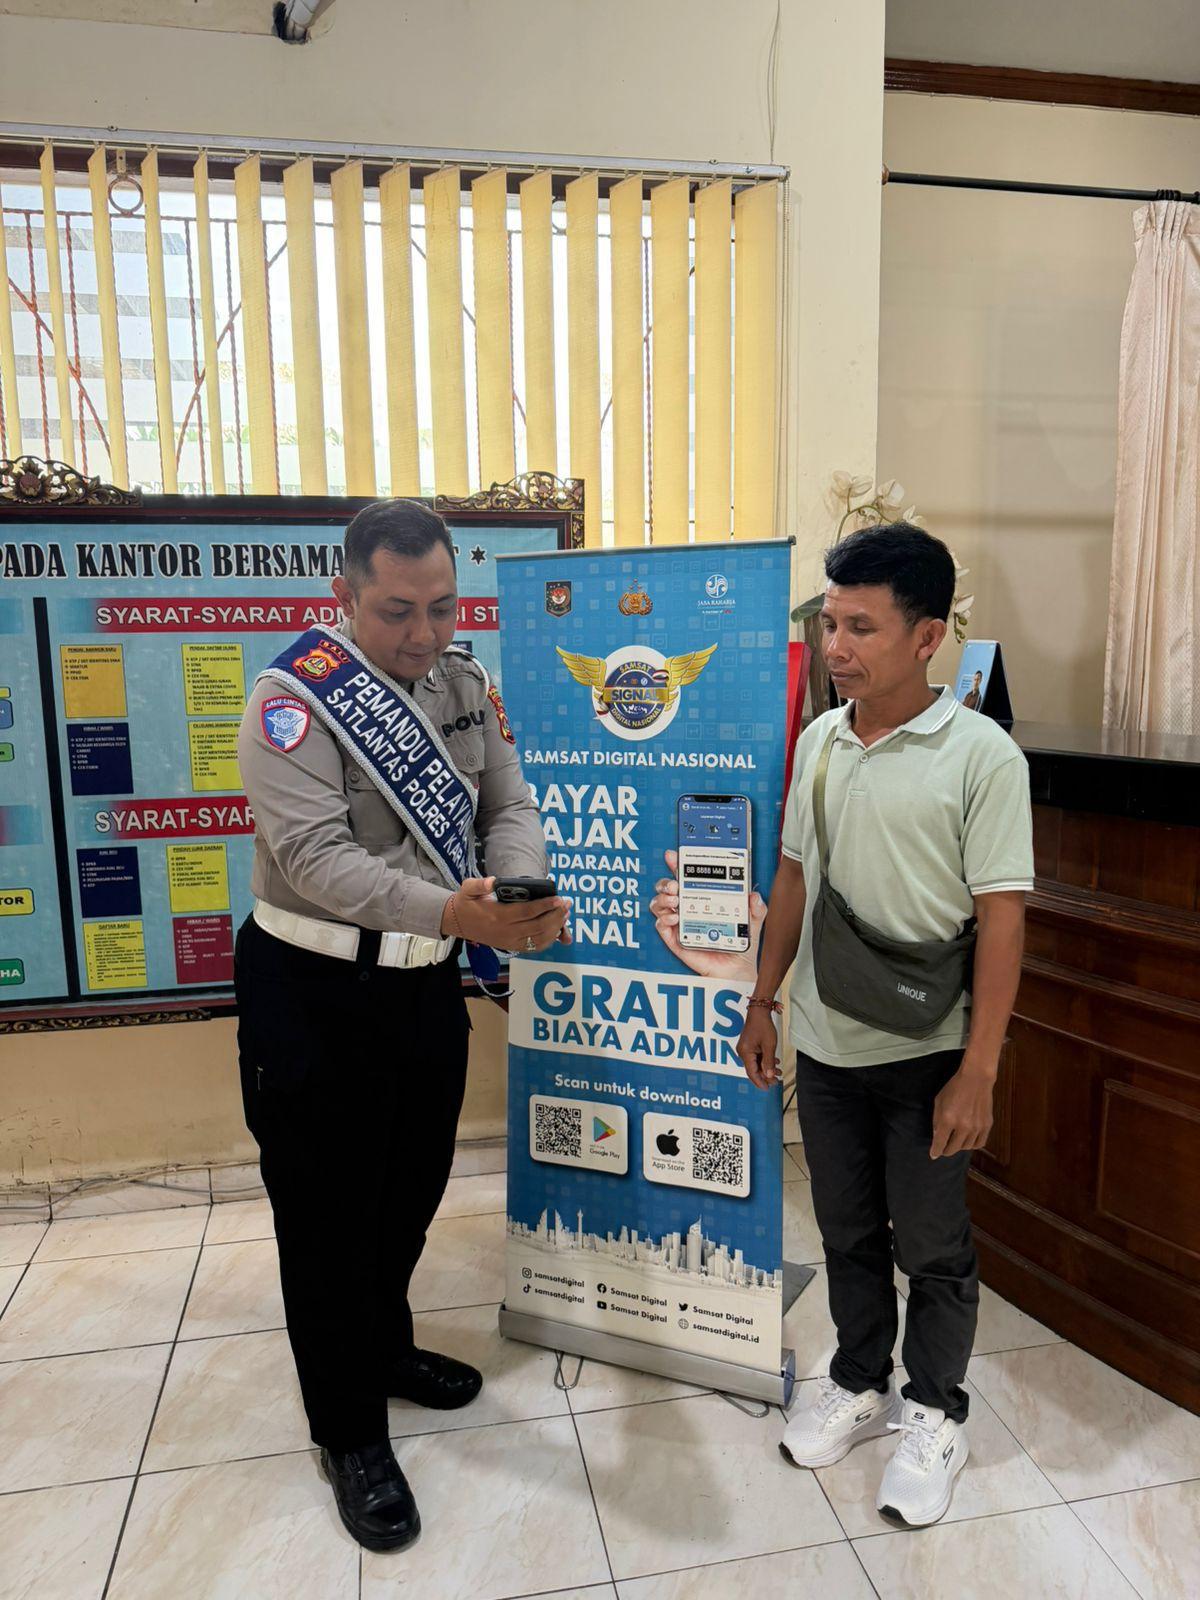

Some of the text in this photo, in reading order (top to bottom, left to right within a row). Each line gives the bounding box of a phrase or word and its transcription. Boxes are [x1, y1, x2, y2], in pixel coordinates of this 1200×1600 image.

[0, 544, 344, 578] ADA KANTOR BERSAMA
[97, 606, 295, 624] SYARAT-SYARAT
[620, 662, 652, 674] SAMSAT
[612, 689, 660, 701] SIGNAL
[611, 707, 632, 726] DIGITAL
[326, 688, 409, 782] SATLANTAS
[402, 778, 450, 838] POLRES
[345, 672, 472, 836] PEMANDU PELAYA
[524, 750, 756, 768] SAMSAT DIGITAL NASIONAL
[96, 806, 255, 832] SYARAT-SYAR
[543, 816, 639, 850] AJAK
[550, 853, 640, 873] DARAAN
[546, 873, 639, 896] MOTOR
[562, 896, 640, 918] LIKASI
[566, 918, 640, 948] NAL
[897, 982, 927, 1002] UNIQUE
[533, 971, 744, 1038] GRATIS
[533, 1017, 744, 1068] BIAYA ADMIN
[554, 1074, 722, 1110] Scan untuk download
[590, 1148, 620, 1159] Google Play
[652, 1162, 685, 1172] App Store
[534, 1272, 585, 1288] samsatdigital
[534, 1288, 585, 1304] samsatdigital
[610, 1288, 667, 1307] Samsat Digital
[610, 1304, 667, 1323] Samsat Digital
[693, 1306, 753, 1326] Samsat Digital
[693, 1323, 759, 1344] samsatdigital.id
